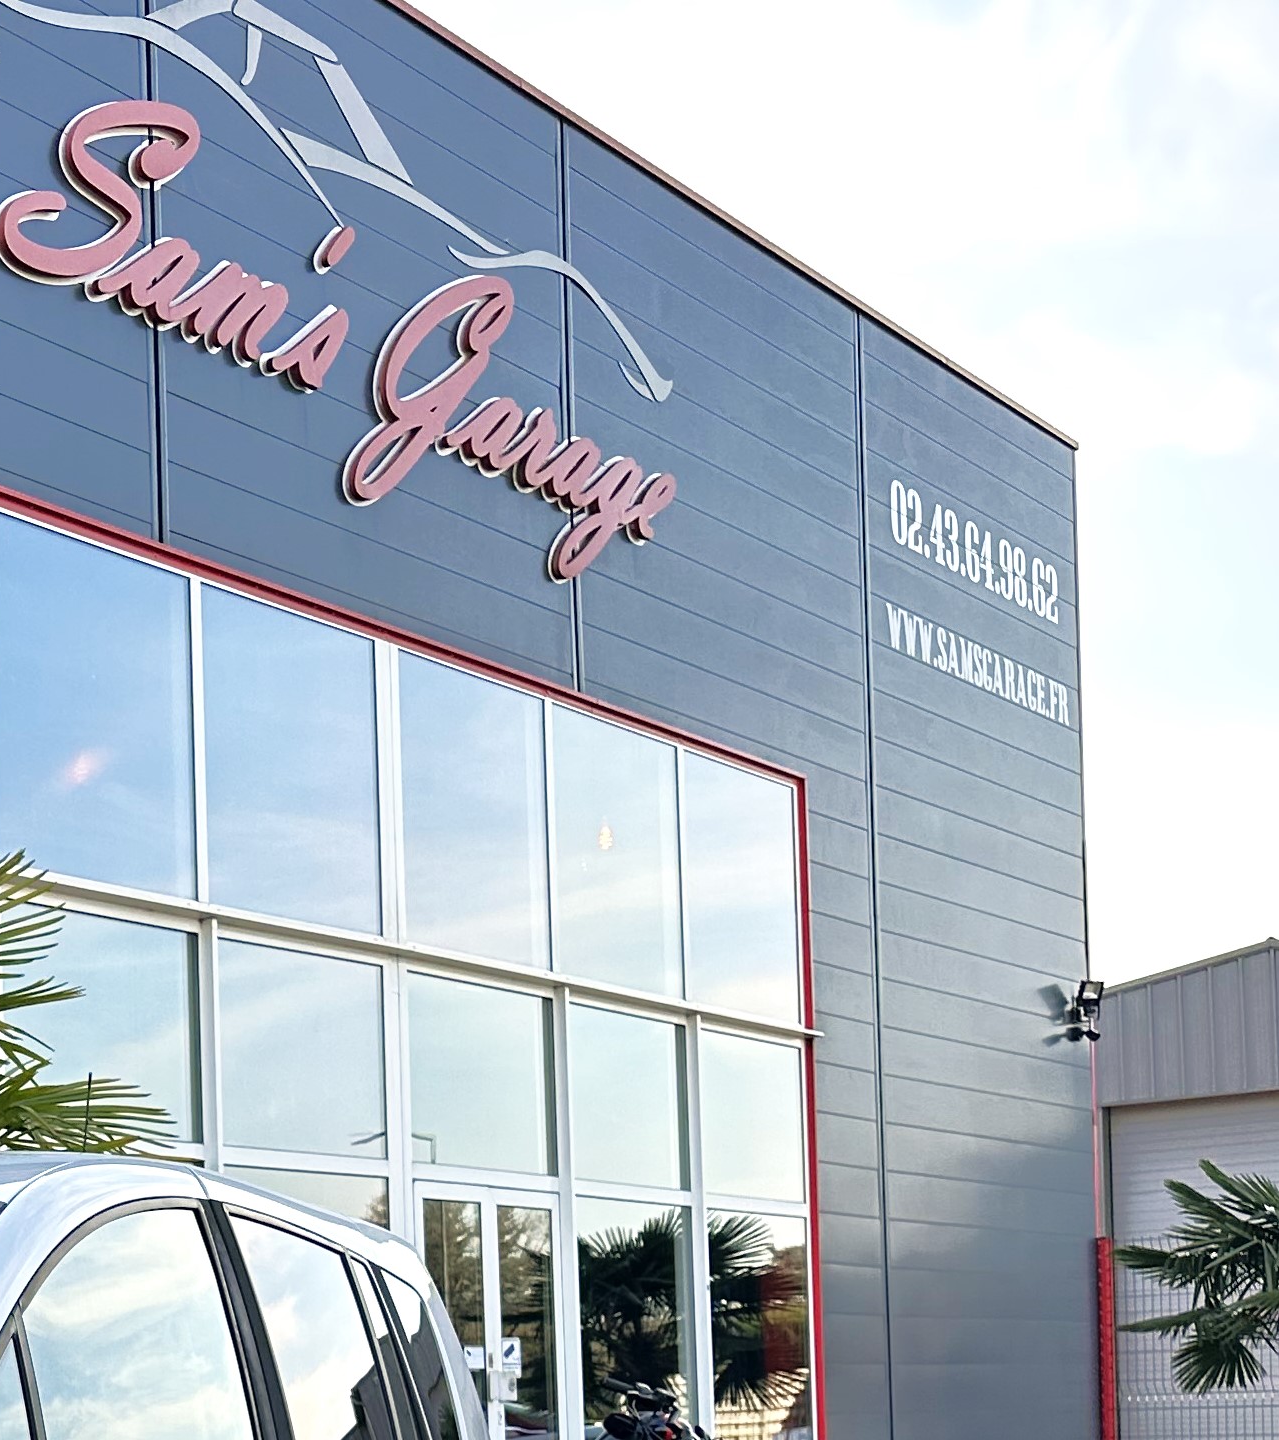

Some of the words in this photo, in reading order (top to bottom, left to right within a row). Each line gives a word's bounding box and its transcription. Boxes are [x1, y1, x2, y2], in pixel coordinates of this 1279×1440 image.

[342, 274, 676, 584] Garage
[890, 479, 1059, 625] 02.43.64.98.62
[885, 602, 1070, 727] WWW.SAMSGARAGE.FR
